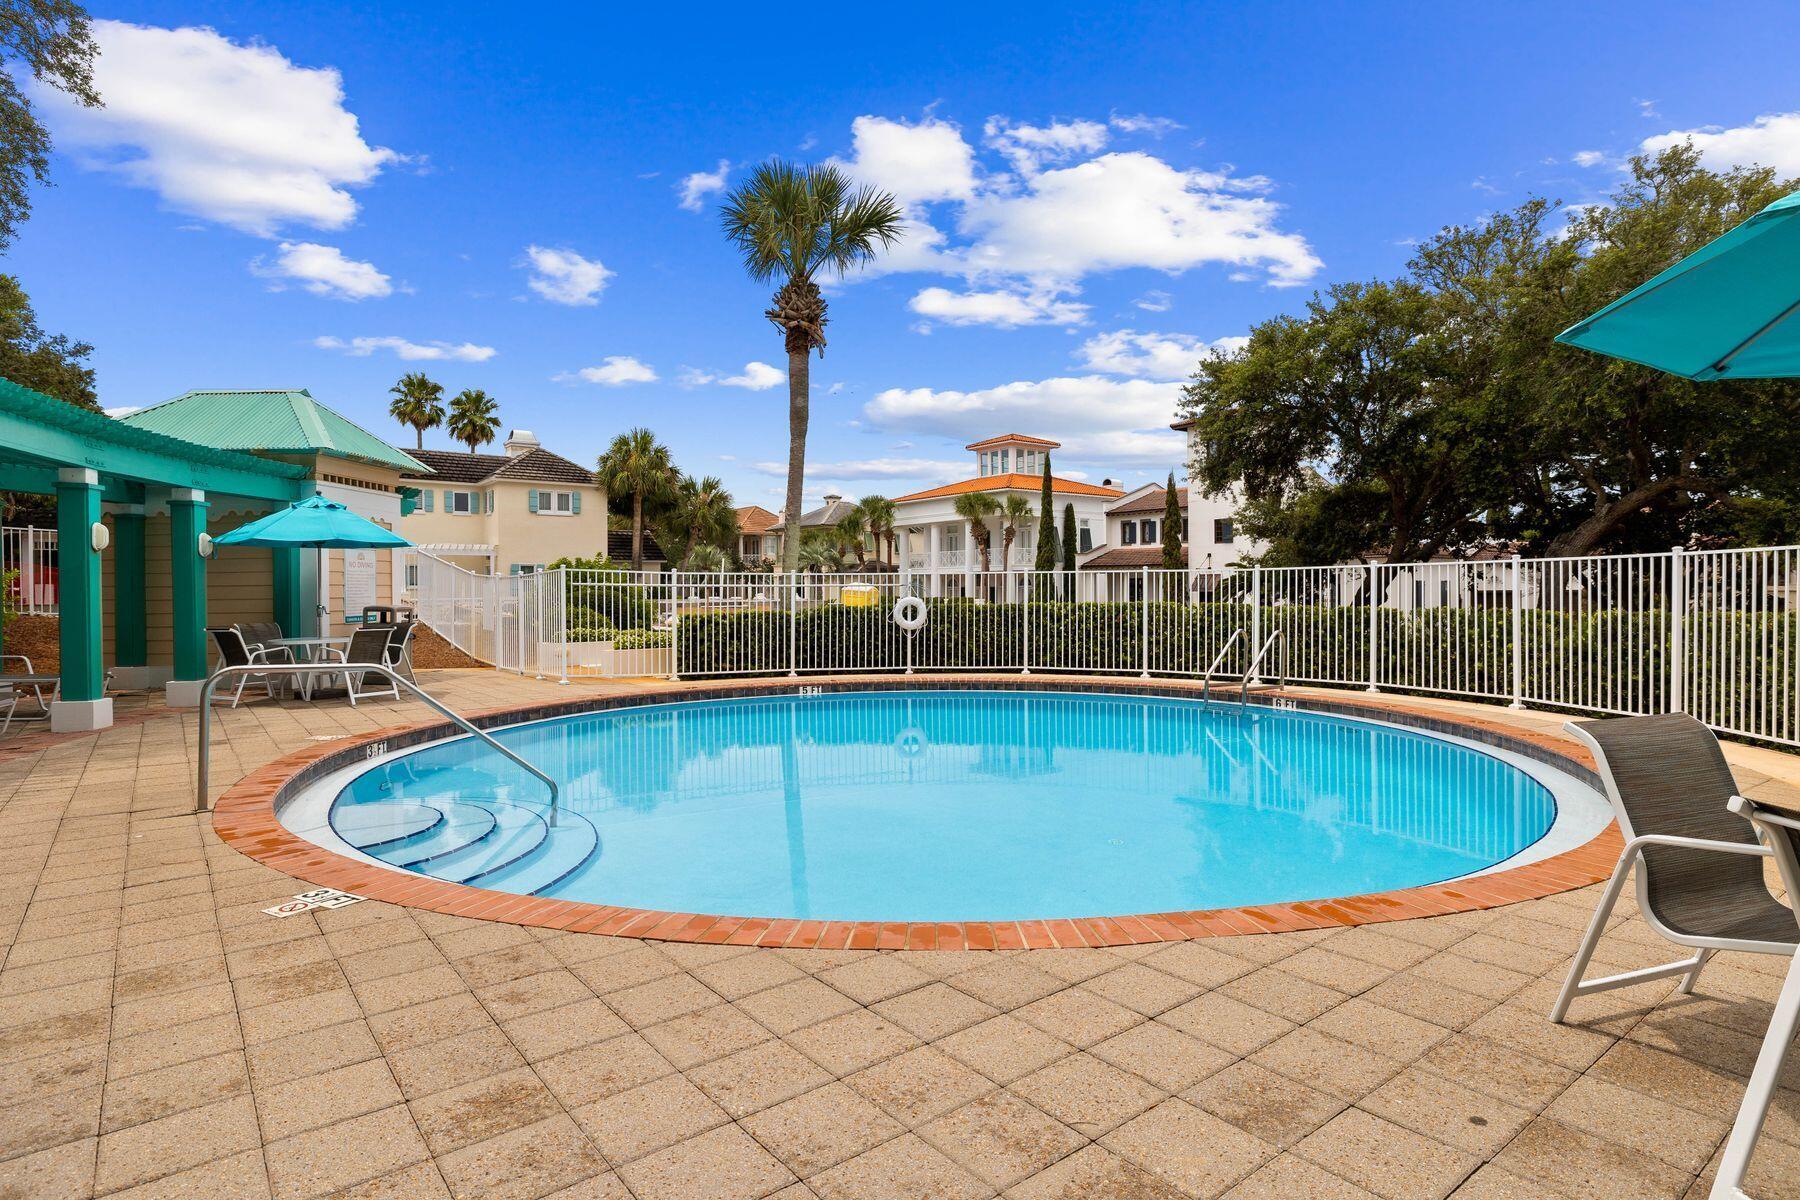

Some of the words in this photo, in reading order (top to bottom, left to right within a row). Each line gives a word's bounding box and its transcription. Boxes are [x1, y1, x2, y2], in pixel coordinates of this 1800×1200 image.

[349, 561, 357, 569] NO
[802, 686, 808, 694] 5
[811, 686, 820, 694] FT
[1275, 698, 1281, 707] 6
[1285, 699, 1295, 709] FT
[377, 741, 386, 756] FT
[320, 893, 362, 907] FT
